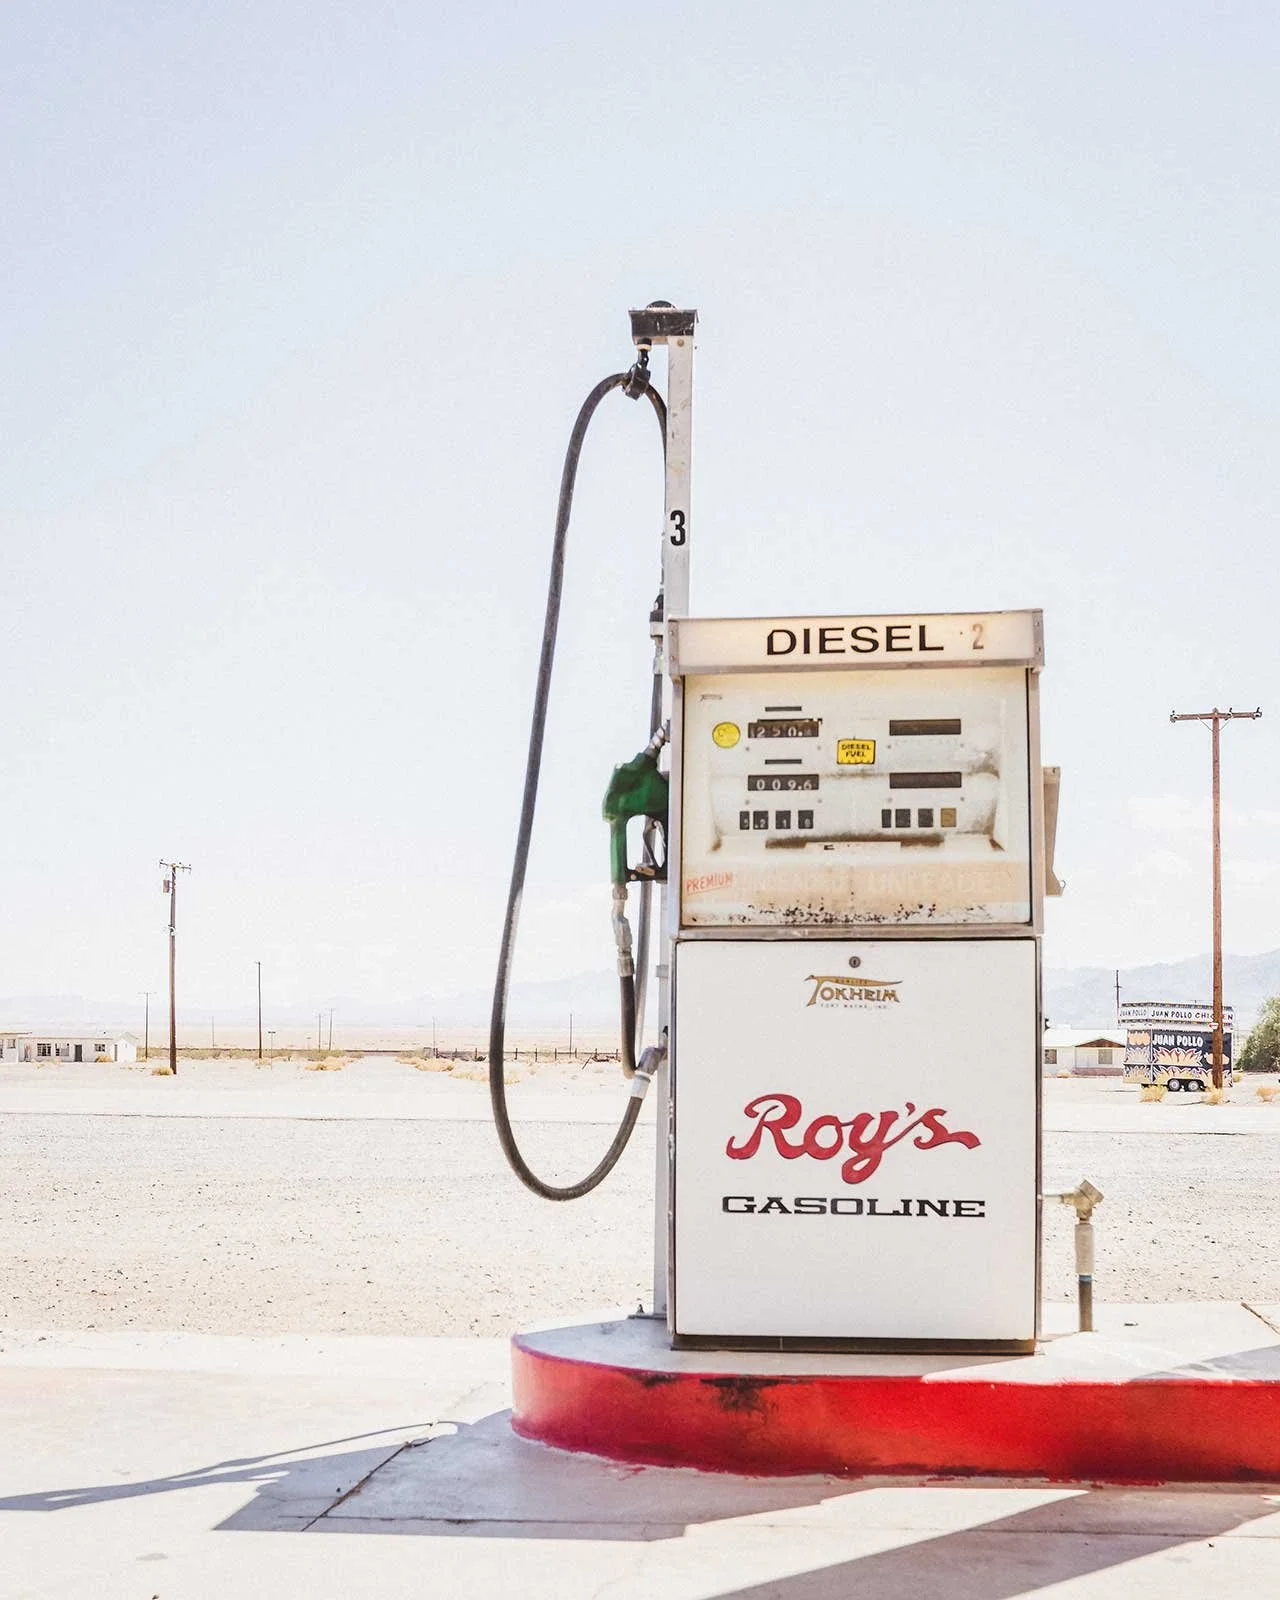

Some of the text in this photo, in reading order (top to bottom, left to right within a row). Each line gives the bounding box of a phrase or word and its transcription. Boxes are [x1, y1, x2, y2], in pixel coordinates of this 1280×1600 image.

[670, 510, 686, 546] 3
[766, 623, 985, 656] DIESEL 2
[686, 871, 733, 894] PREMIUM
[804, 974, 903, 1006] TOKHEIM
[1151, 1010, 1169, 1018] JUAN
[1171, 1011, 1192, 1019] POLLO
[1152, 1034, 1204, 1047] JUAN POLLO
[726, 1093, 982, 1184] Roy's
[722, 1196, 985, 1217] GASOLINE
